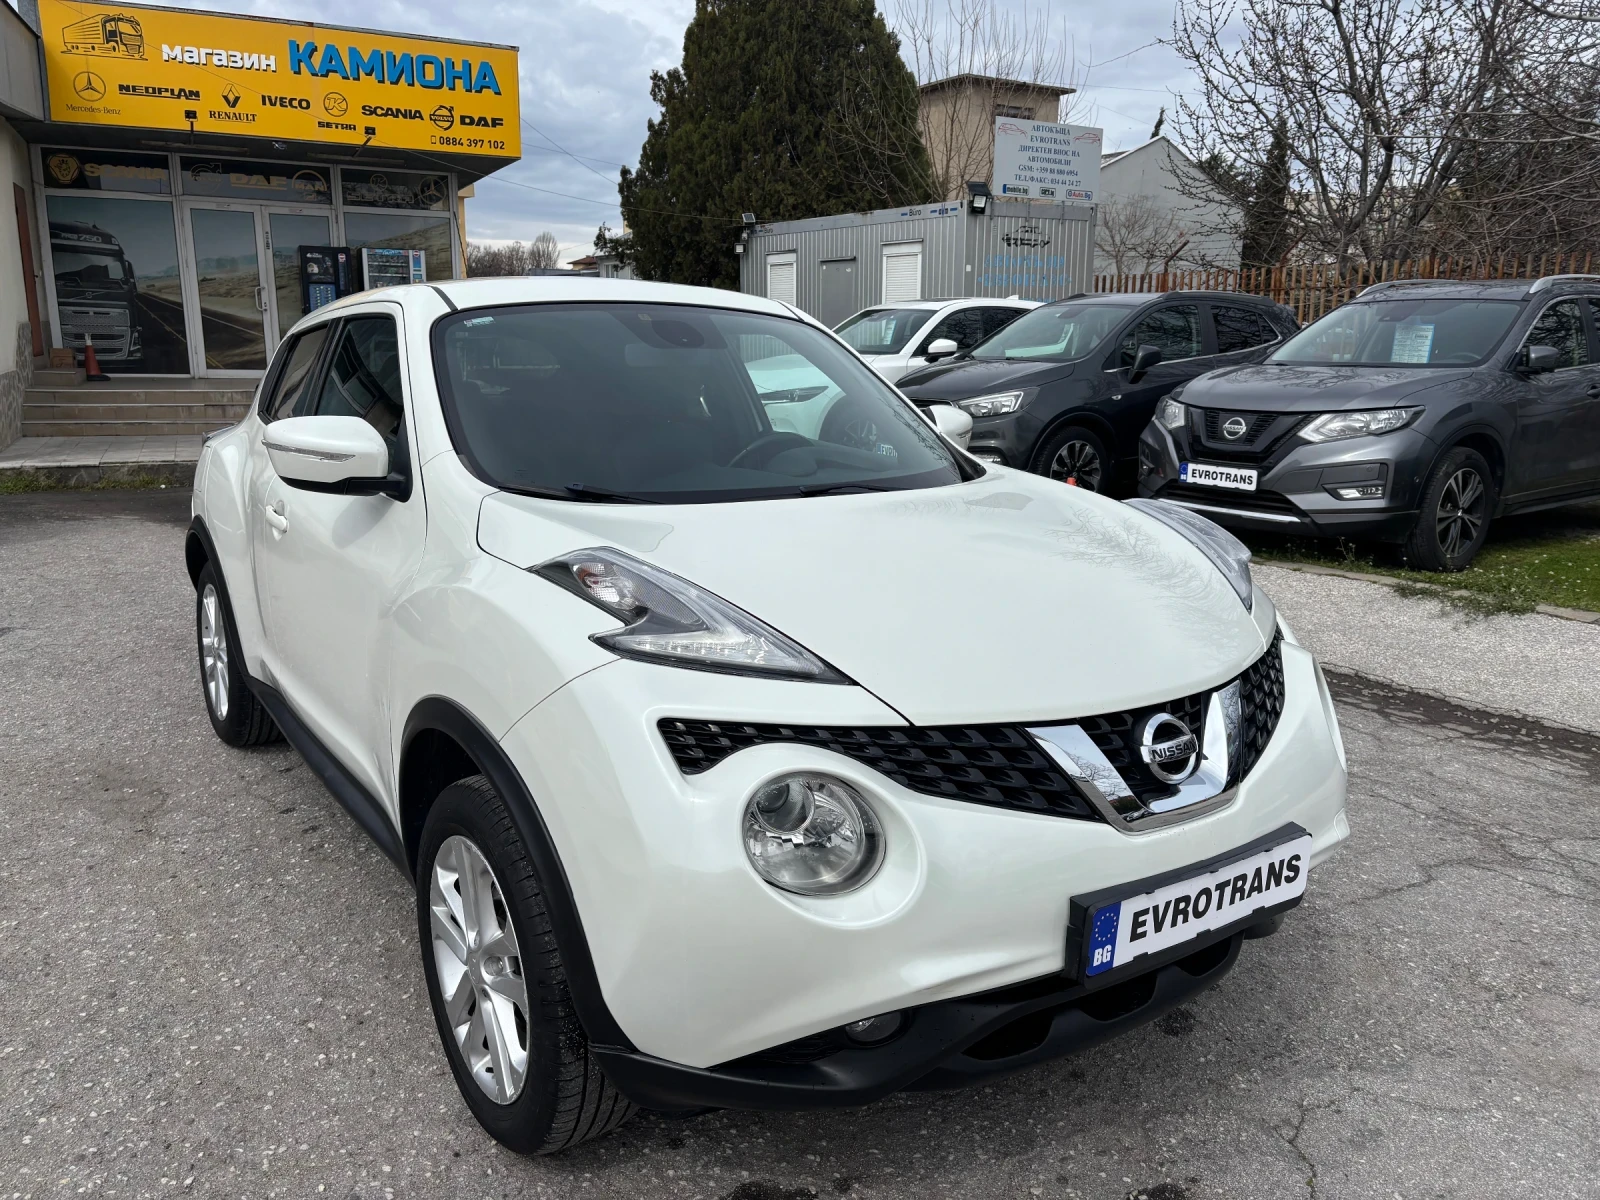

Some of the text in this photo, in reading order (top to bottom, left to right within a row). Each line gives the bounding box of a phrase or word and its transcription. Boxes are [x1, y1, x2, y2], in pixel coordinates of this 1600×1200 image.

[162, 40, 502, 96] магазин КАМИОНА
[118, 84, 200, 100] NEOPLAN
[261, 94, 310, 110] IVECO
[66, 104, 121, 115] Mercedes-Benz
[209, 110, 257, 122] RENAULT
[361, 104, 424, 120] SCANIA
[318, 120, 356, 131] SETRA
[460, 115, 504, 128] DAF
[1031, 125, 1070, 136] АВТОКЪЩА
[439, 136, 505, 150] 0884 397 102
[1030, 135, 1070, 146] EVROTRANS
[1018, 145, 1052, 155] ДИРЕКТЕН
[1053, 148, 1070, 156] ВНОС
[1027, 156, 1071, 166] АВТОМОБИЛИ
[84, 163, 166, 180] SCANIA
[1018, 164, 1034, 172] GSM:
[230, 173, 287, 187] DAF
[1007, 186, 1028, 195] mobile.bg
[1192, 469, 1253, 485] EVROTRANS
[1152, 738, 1197, 760] NISSAN
[1092, 854, 1301, 967] BG EVROTRANS
